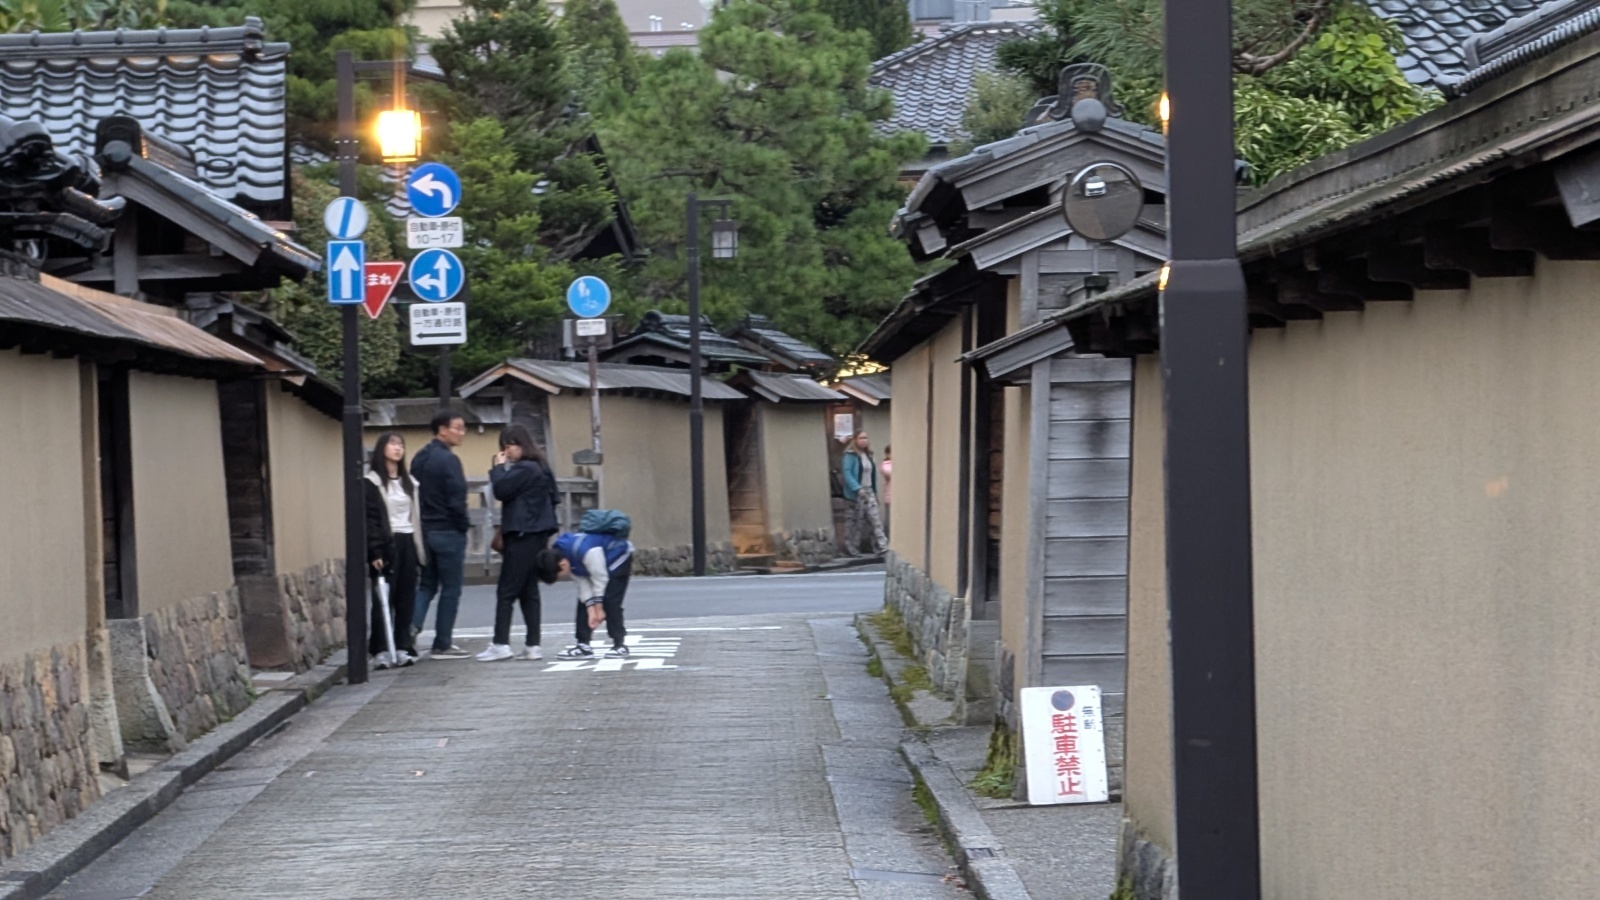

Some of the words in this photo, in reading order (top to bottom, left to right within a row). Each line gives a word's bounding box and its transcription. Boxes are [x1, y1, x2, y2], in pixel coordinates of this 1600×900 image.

[365, 273, 393, 286] まれ
[1051, 712, 1083, 797] 駐車禁止
